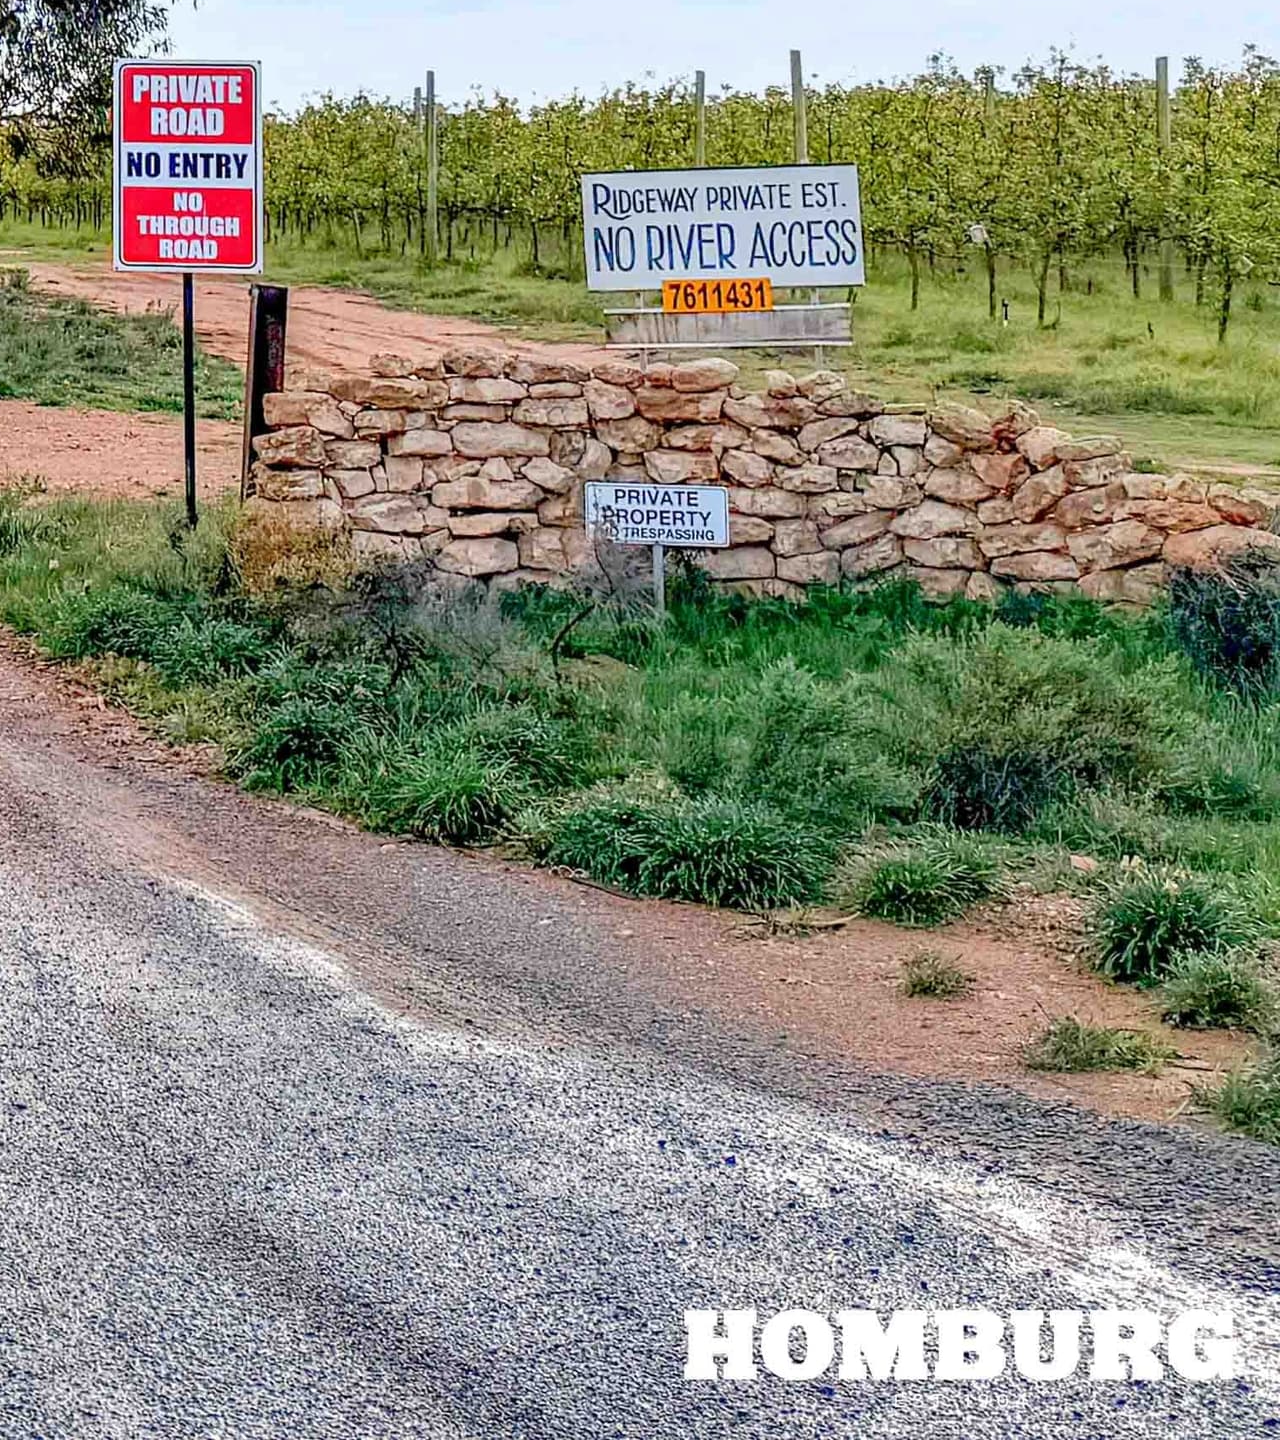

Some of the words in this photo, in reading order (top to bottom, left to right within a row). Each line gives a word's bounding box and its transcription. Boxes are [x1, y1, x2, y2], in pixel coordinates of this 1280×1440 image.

[132, 74, 243, 104] PRIVATE
[150, 107, 225, 136] ROAD
[127, 152, 161, 178] NO
[168, 153, 248, 179] ENTRY
[173, 192, 204, 212] NO
[706, 184, 791, 211] PRIVATE
[801, 182, 846, 209] EST.
[136, 215, 240, 237] THROUGH
[159, 239, 218, 260] ROAD
[593, 226, 636, 272] NO
[646, 222, 737, 271] RIVER
[748, 219, 857, 268] ACCESS
[668, 283, 766, 309] 7611431
[614, 489, 699, 507] PRIVATE
[602, 506, 712, 527] PROPERTY
[623, 527, 715, 541] TRESPASSING
